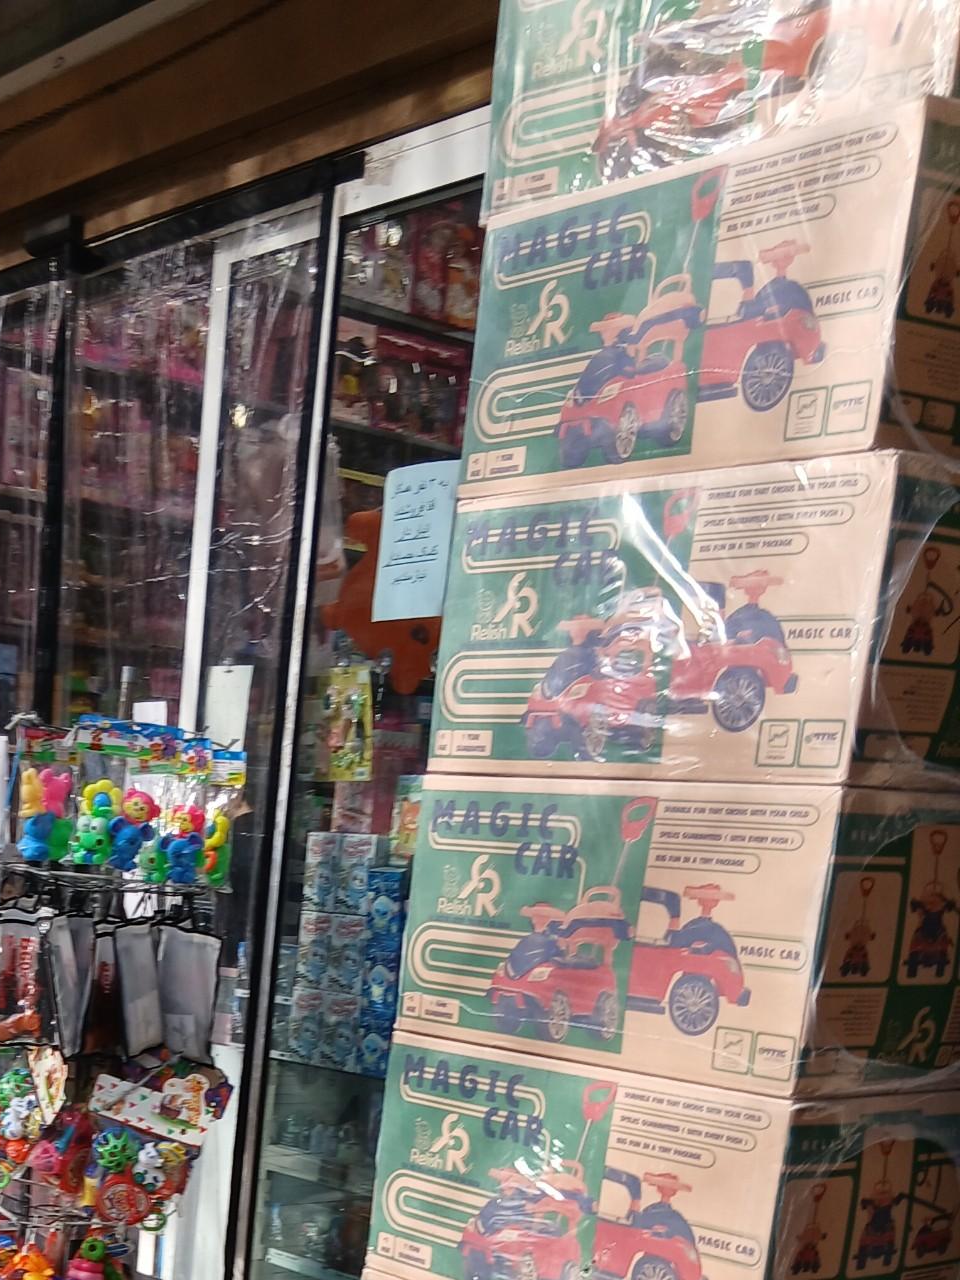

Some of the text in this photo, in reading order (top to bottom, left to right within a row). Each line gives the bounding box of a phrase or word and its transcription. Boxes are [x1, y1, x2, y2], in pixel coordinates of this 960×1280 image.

[584, 242, 650, 290] CAR
[815, 291, 850, 307] MAGIC
[504, 334, 540, 357] Relish
[466, 508, 600, 555] MAGIC
[471, 623, 507, 641] Relish
[787, 627, 853, 640] MAGIC CAR
[432, 799, 558, 840] MAGIC
[513, 842, 578, 879] CAR
[437, 897, 472, 916] Relish
[740, 945, 801, 961] MAGIC CAR
[404, 1053, 524, 1109] MAGIC
[483, 1106, 544, 1147] CAR
[409, 1148, 444, 1170] Relish
[697, 1234, 755, 1257] MAGIC CAR
